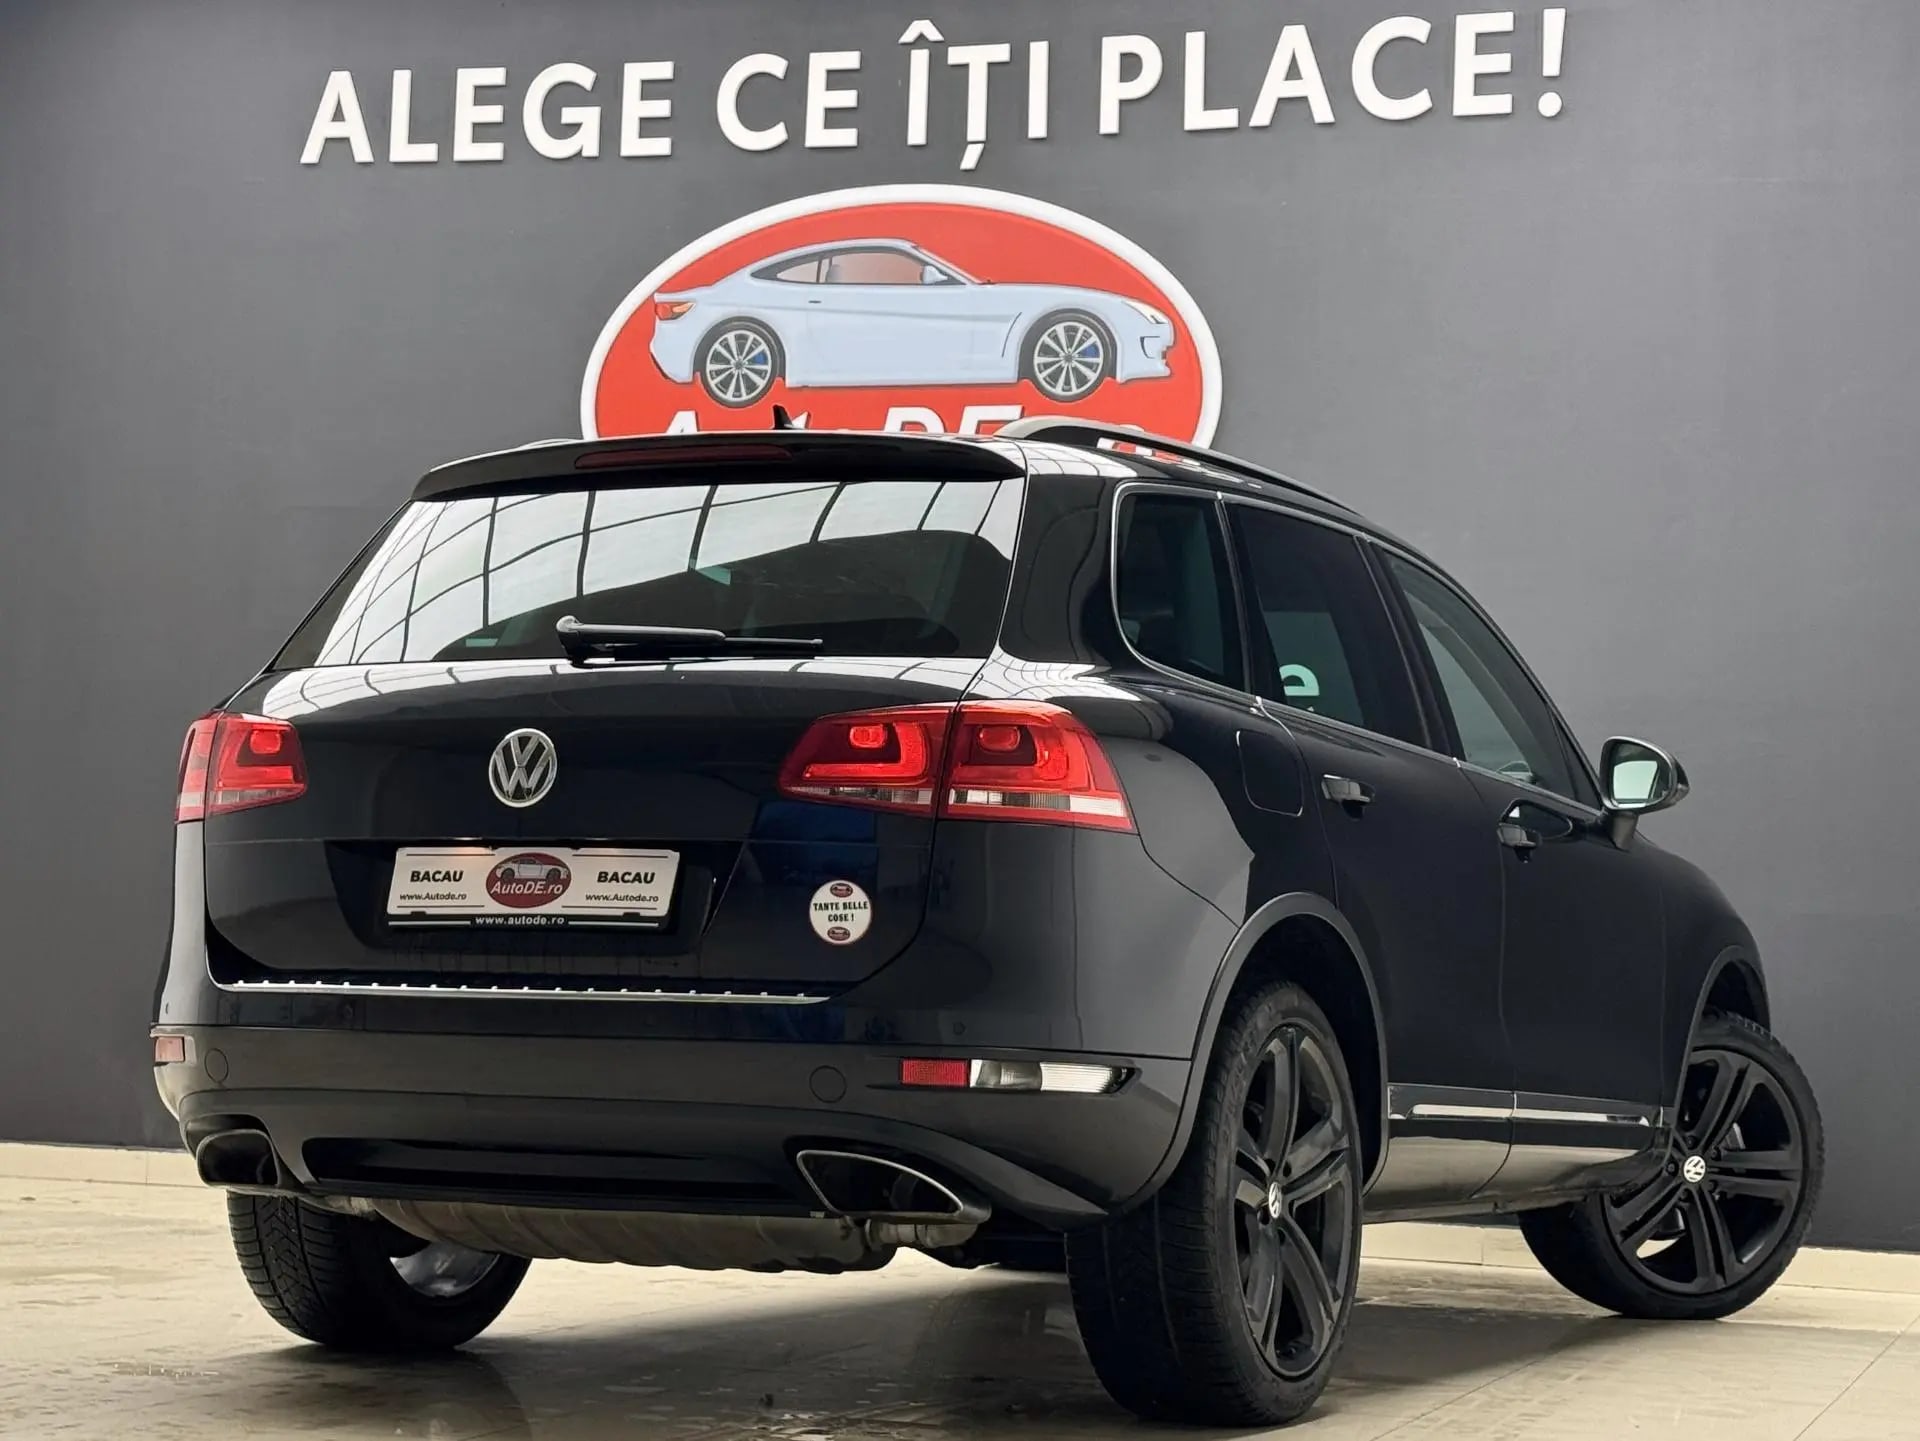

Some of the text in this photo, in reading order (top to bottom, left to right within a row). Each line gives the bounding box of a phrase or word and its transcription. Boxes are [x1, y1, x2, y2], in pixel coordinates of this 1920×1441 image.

[300, 61, 674, 165] ALEGE
[716, 50, 861, 152] CE
[410, 870, 464, 883] BACAU
[597, 871, 656, 884] BACAU
[489, 881, 563, 896] AutoDE.ro
[399, 892, 467, 901] www.Autode.ro
[585, 894, 659, 903] www.Autode.ro
[813, 901, 868, 911] TANTE BELLE
[475, 915, 565, 926] www.autode.ro
